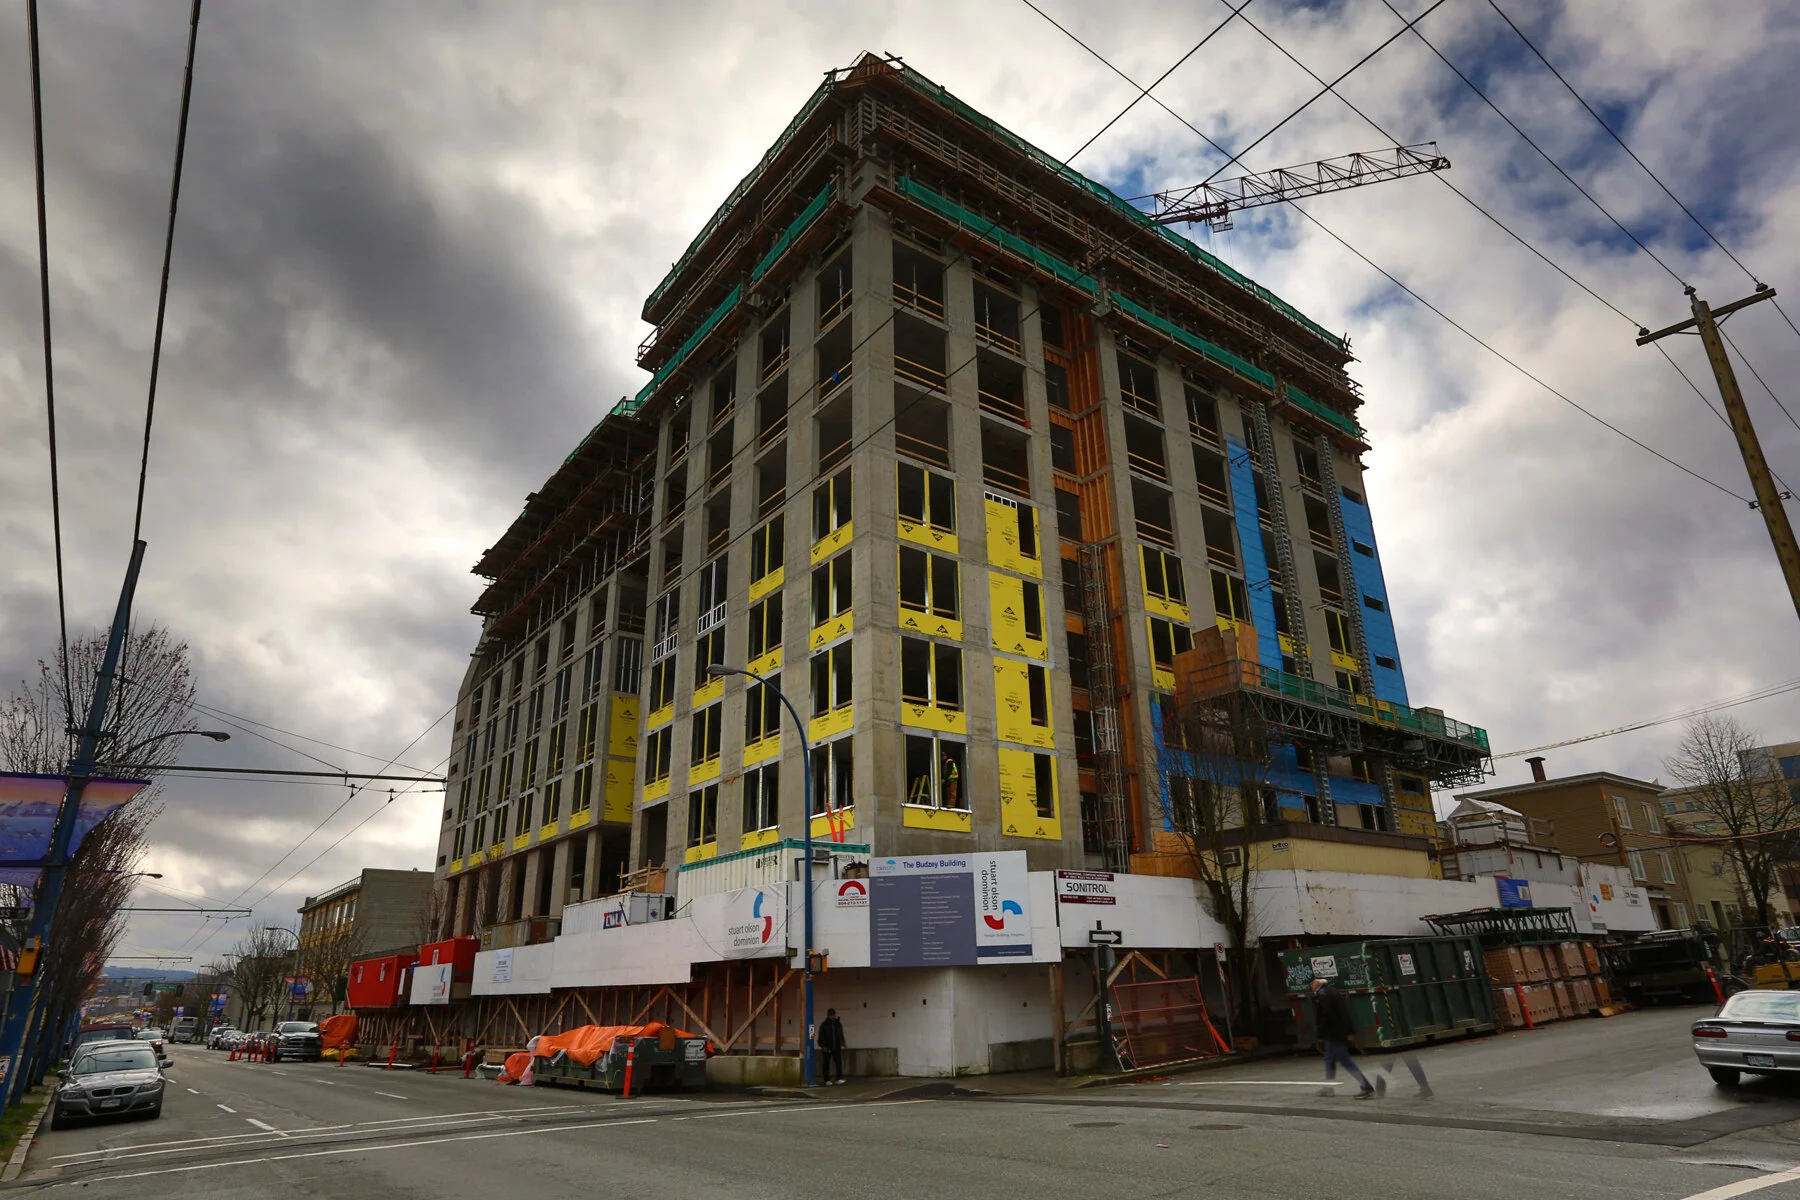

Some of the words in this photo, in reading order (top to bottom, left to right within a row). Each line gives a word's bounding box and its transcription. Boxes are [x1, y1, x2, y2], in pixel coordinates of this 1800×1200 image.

[902, 861, 915, 869] The
[916, 861, 938, 869] Budzey
[940, 860, 966, 868] Building
[990, 860, 998, 886] stuart
[981, 869, 990, 911] dominion
[1066, 882, 1109, 894] SONITROL
[991, 887, 999, 911] olson
[728, 926, 744, 936] stuart
[745, 923, 760, 934] olson
[733, 936, 760, 947] dominion
